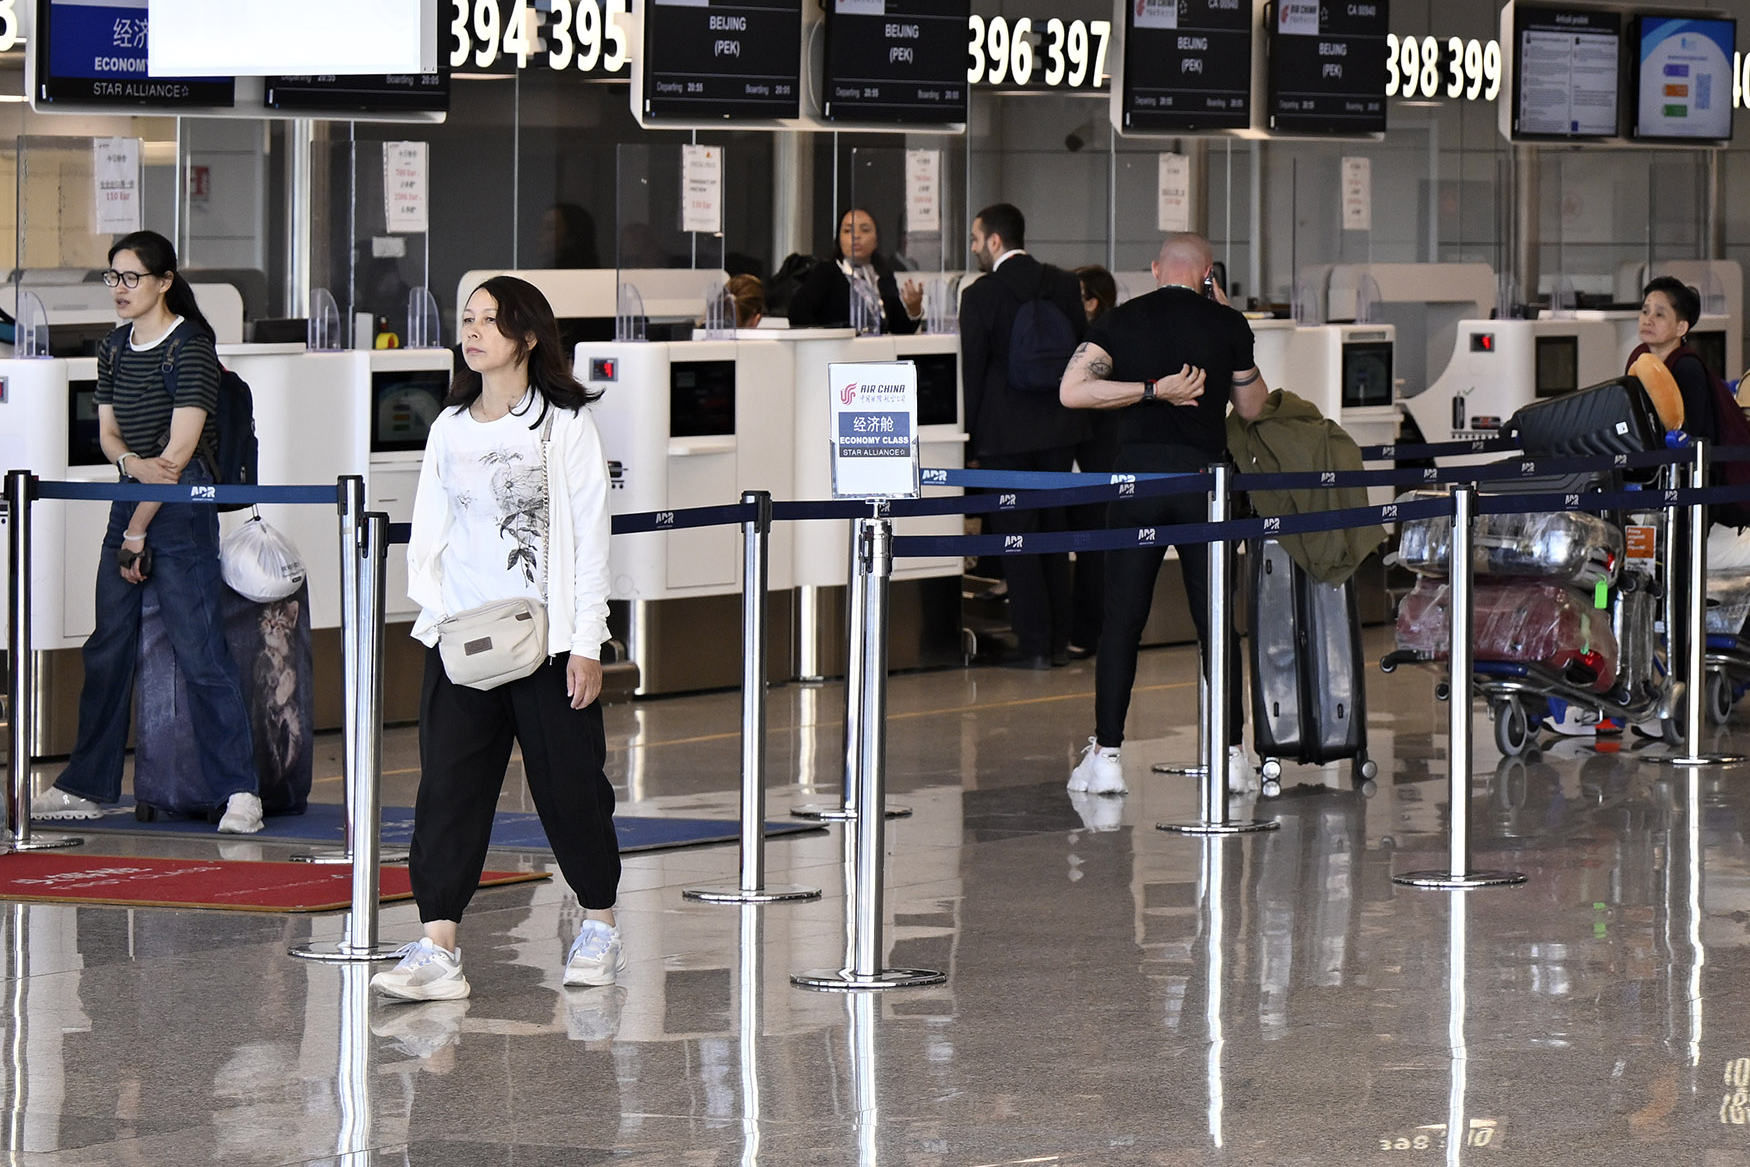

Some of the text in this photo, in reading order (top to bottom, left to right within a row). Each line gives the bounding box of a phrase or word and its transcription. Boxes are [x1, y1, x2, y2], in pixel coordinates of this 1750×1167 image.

[709, 16, 746, 32] BEIJING
[885, 24, 919, 39] BEIJING
[113, 18, 148, 48] 经济
[714, 39, 740, 56] (PEK)
[967, 14, 1032, 86] 396
[1178, 37, 1208, 51] BEIJING
[1319, 42, 1347, 56] BEIJING
[889, 47, 913, 64] (PEK)
[1044, 18, 1111, 88] 397
[1181, 58, 1203, 74] (PEK)
[1323, 63, 1342, 79] (PEK)
[1386, 34, 1439, 98] 398
[1446, 37, 1501, 101] 399
[93, 83, 181, 98] STAR ALLIANCE
[860, 384, 906, 394] AIR CHINA
[853, 416, 894, 432] 经济舱
[839, 436, 881, 444] ECONOMY
[843, 448, 862, 456] STAR
[922, 470, 947, 481] ADR
